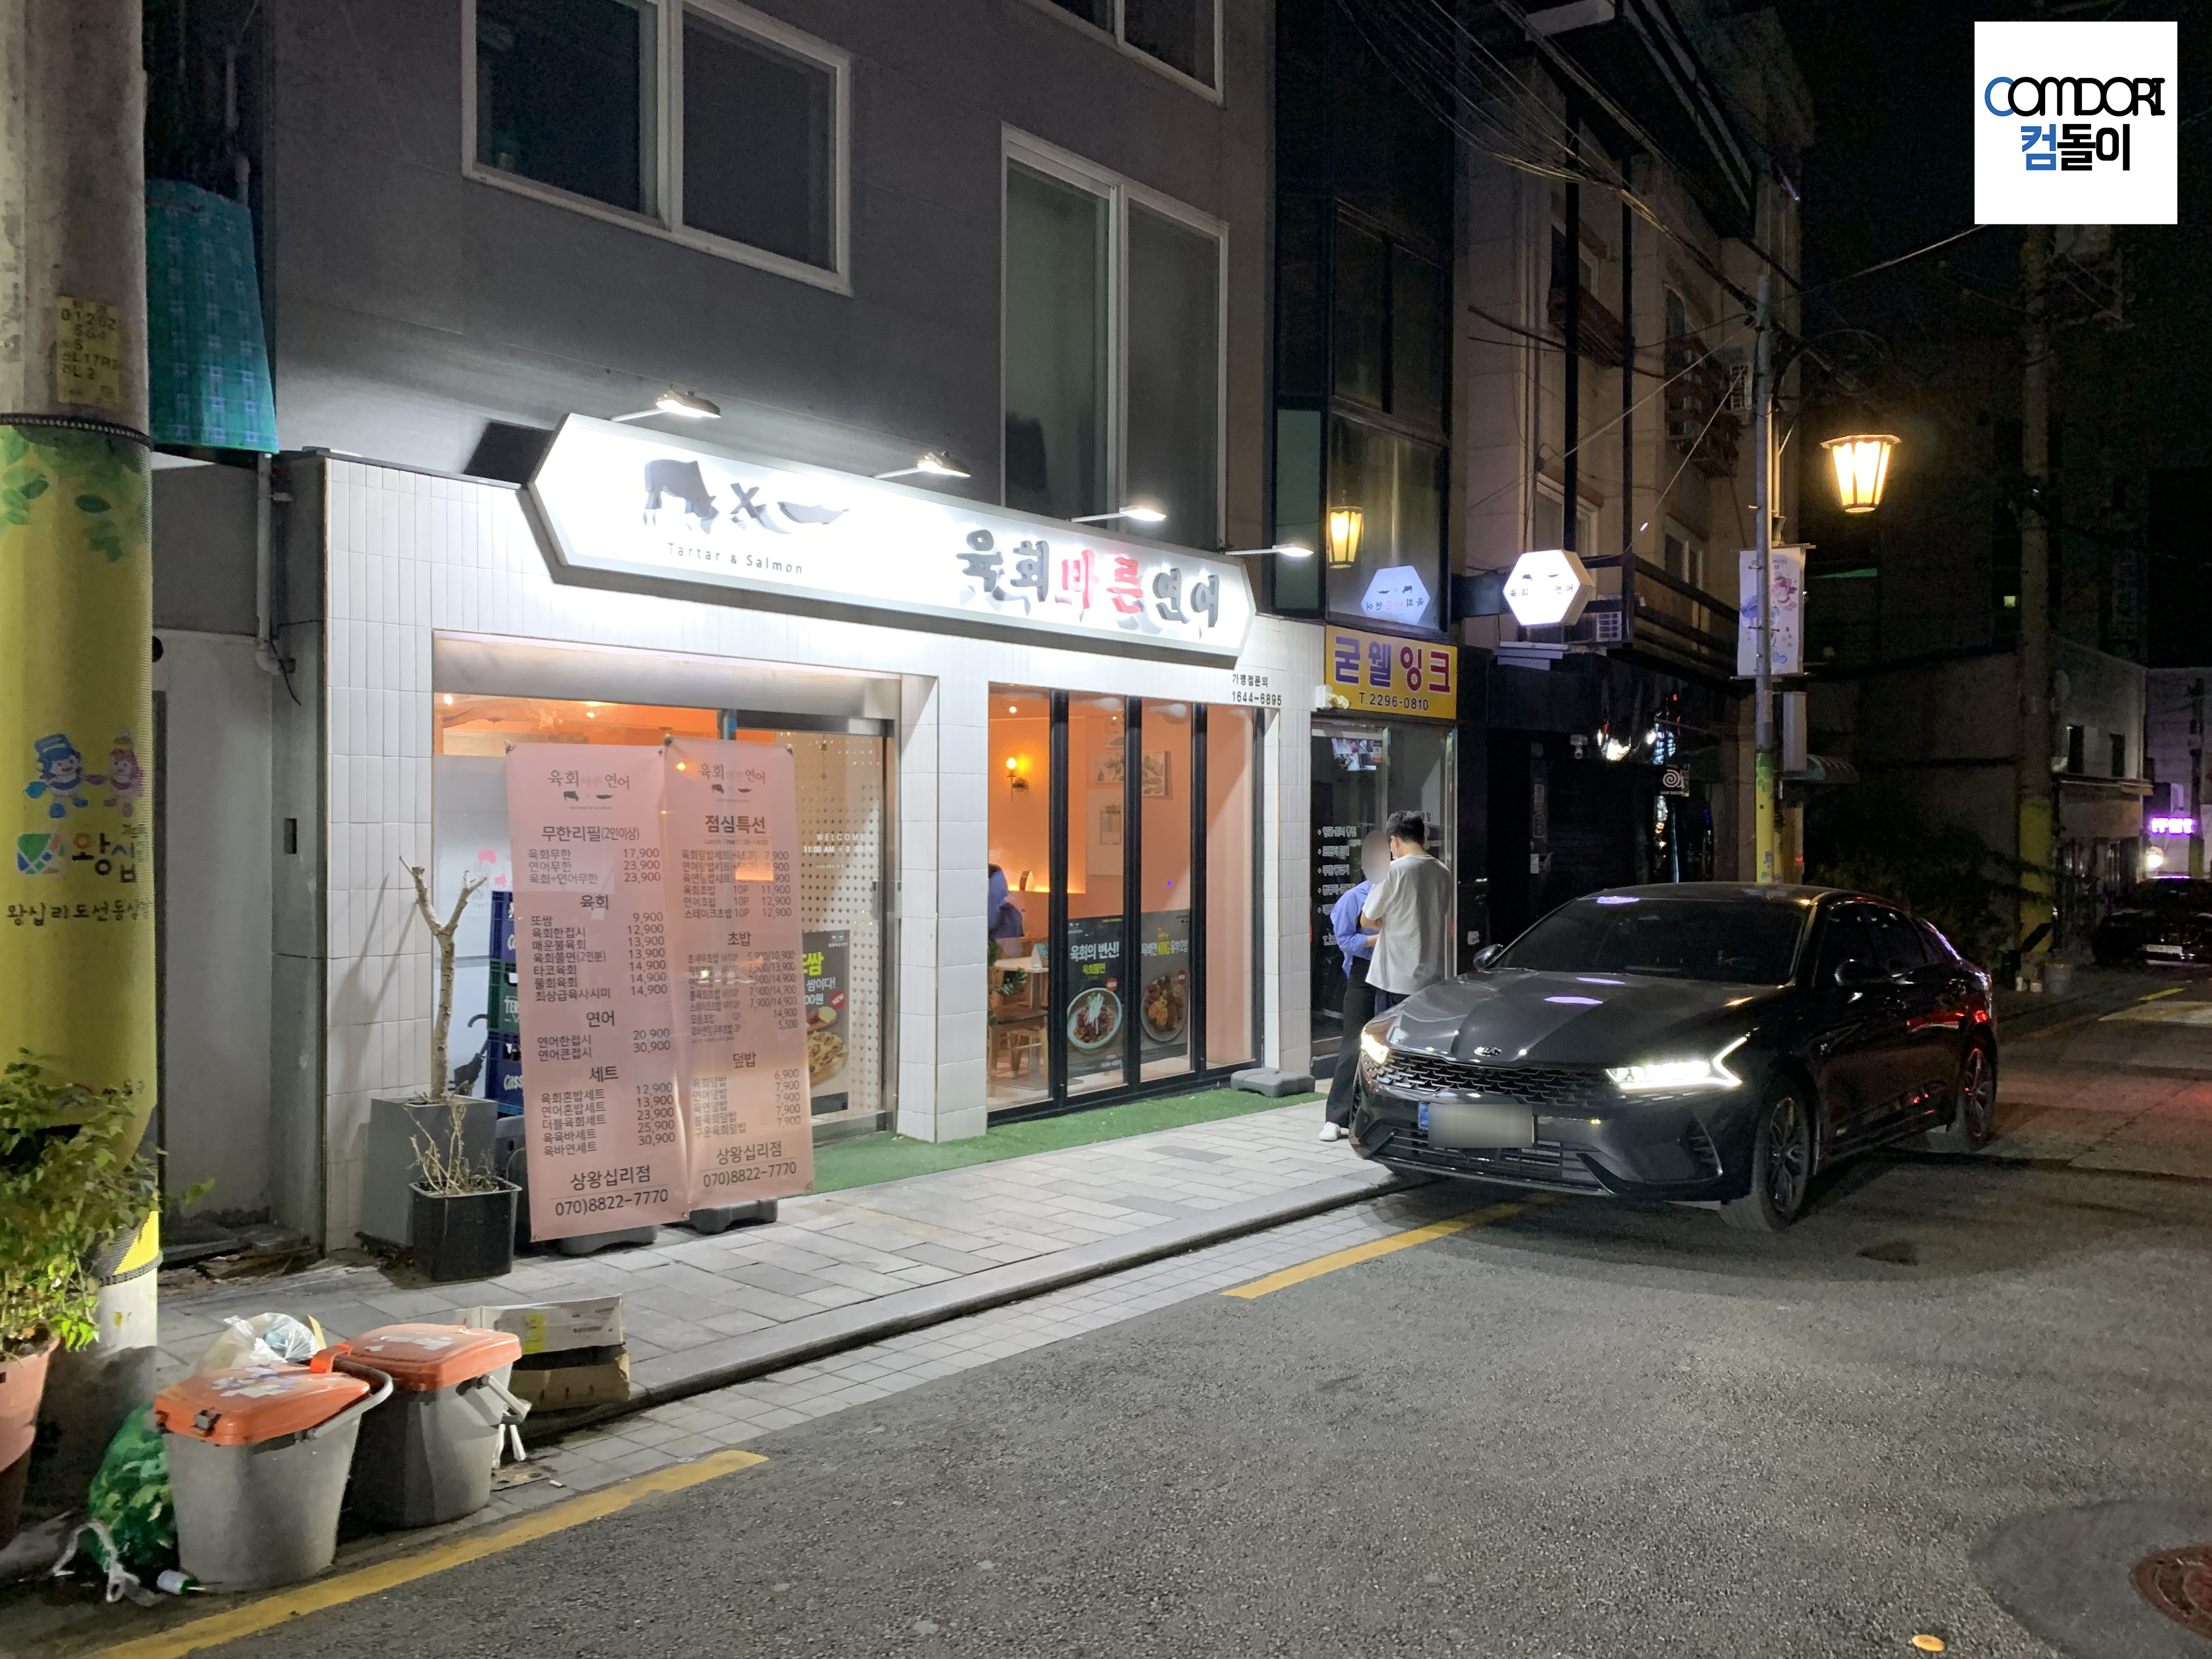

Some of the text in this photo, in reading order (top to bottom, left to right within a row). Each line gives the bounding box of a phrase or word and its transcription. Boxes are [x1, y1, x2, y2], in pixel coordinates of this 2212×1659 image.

[668, 542, 804, 575] Tartar & Salmon
[955, 528, 1220, 628] 육회바른연어
[1232, 673, 1268, 688] 가맹점문의
[1232, 690, 1282, 706] 1644-6895
[1358, 691, 1429, 711] T.2296-0810
[705, 815, 766, 834] 점심특선
[528, 848, 659, 860] 육회무한 17,900
[765, 850, 789, 862] 7,900
[804, 845, 822, 854] 11:00
[528, 860, 660, 873] 연어무한 23,900
[529, 872, 661, 885] 육회+연어무한 23,900
[684, 885, 791, 896] 육회초밥 10P 11,900
[579, 894, 609, 911] 육회
[684, 896, 791, 907] 연어초밥 10P 12,900
[531, 912, 664, 927] 또쌈 9,900
[685, 907, 792, 919] 스테이크초밥 10P 12,900
[531, 924, 664, 939] 육회한접시 12,900
[727, 932, 751, 946] 초밥
[532, 936, 665, 951] 매운불육회 13,900
[1070, 941, 1120, 962] 육회의 변신!
[629, 948, 665, 960] 13,900
[534, 960, 666, 976] 타코육회 14,900
[534, 972, 667, 989] 물회육회 14,900
[535, 984, 668, 1002] 최상급육사시미 14,900
[749, 996, 797, 1009] 7,900/14,900
[586, 1011, 616, 1028] 연어
[774, 1007, 798, 1020] 14,900
[778, 1019, 798, 1030] 5,500
[537, 1028, 670, 1048] 연어한접시 20,900
[538, 1041, 672, 1062] 연어큰접시 30,900
[732, 1052, 757, 1068] 덮밥
[589, 1065, 619, 1083] 세트
[774, 1068, 799, 1080] 6,900
[540, 1082, 674, 1104] 육회혼밥세트 12,900
[775, 1080, 800, 1092] 7,900
[541, 1094, 674, 1118] 연어혼밥세트 13,900
[775, 1092, 800, 1104] 7,900
[776, 1103, 801, 1116] 7,900
[542, 1107, 675, 1131] 더블육회세트 23,900
[776, 1115, 802, 1128] 7,900
[542, 1120, 675, 1144] 육육바세트 25,900
[543, 1132, 676, 1158] 육바연세트 30,900
[716, 1140, 782, 1166] 상왕십리점
[570, 1165, 652, 1192] 상왕십리점
[703, 1161, 797, 1188] 070)8822-7770
[555, 1188, 668, 1217] 070)8822-7770
